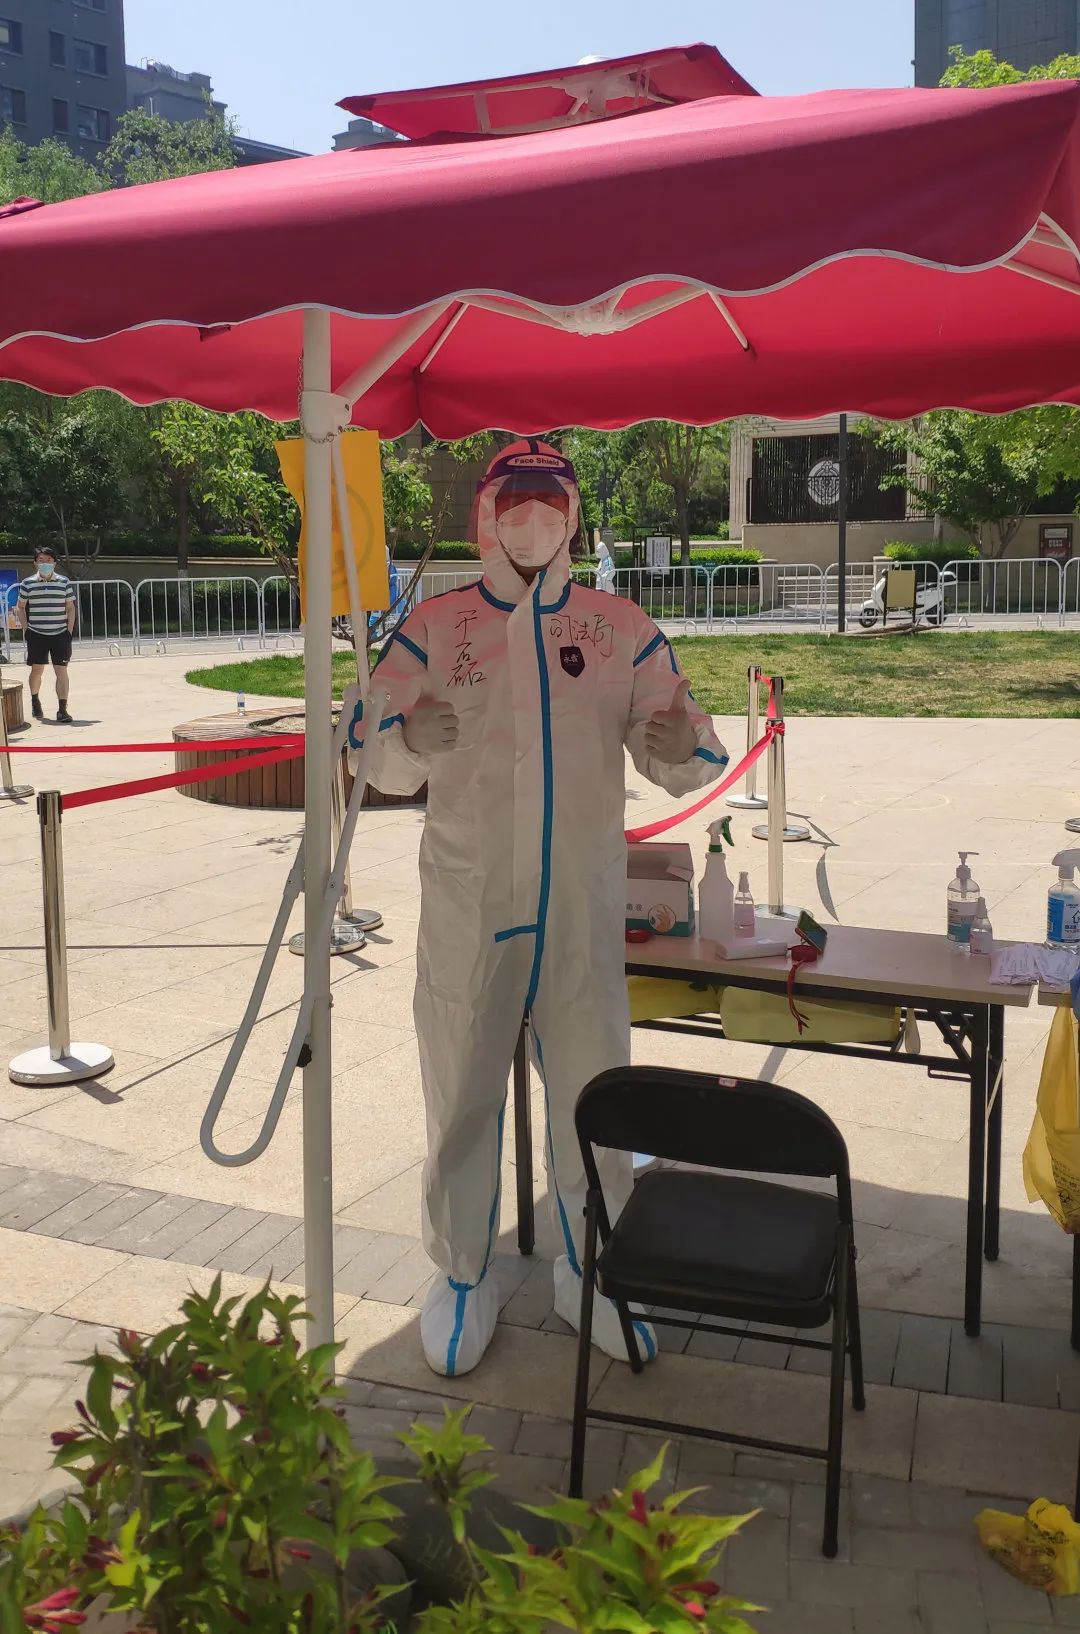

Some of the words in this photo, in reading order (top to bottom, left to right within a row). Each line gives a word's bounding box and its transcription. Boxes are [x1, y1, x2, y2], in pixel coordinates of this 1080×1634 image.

[514, 457, 535, 465] Face
[536, 457, 560, 466] Shield
[550, 612, 614, 658] 司法局
